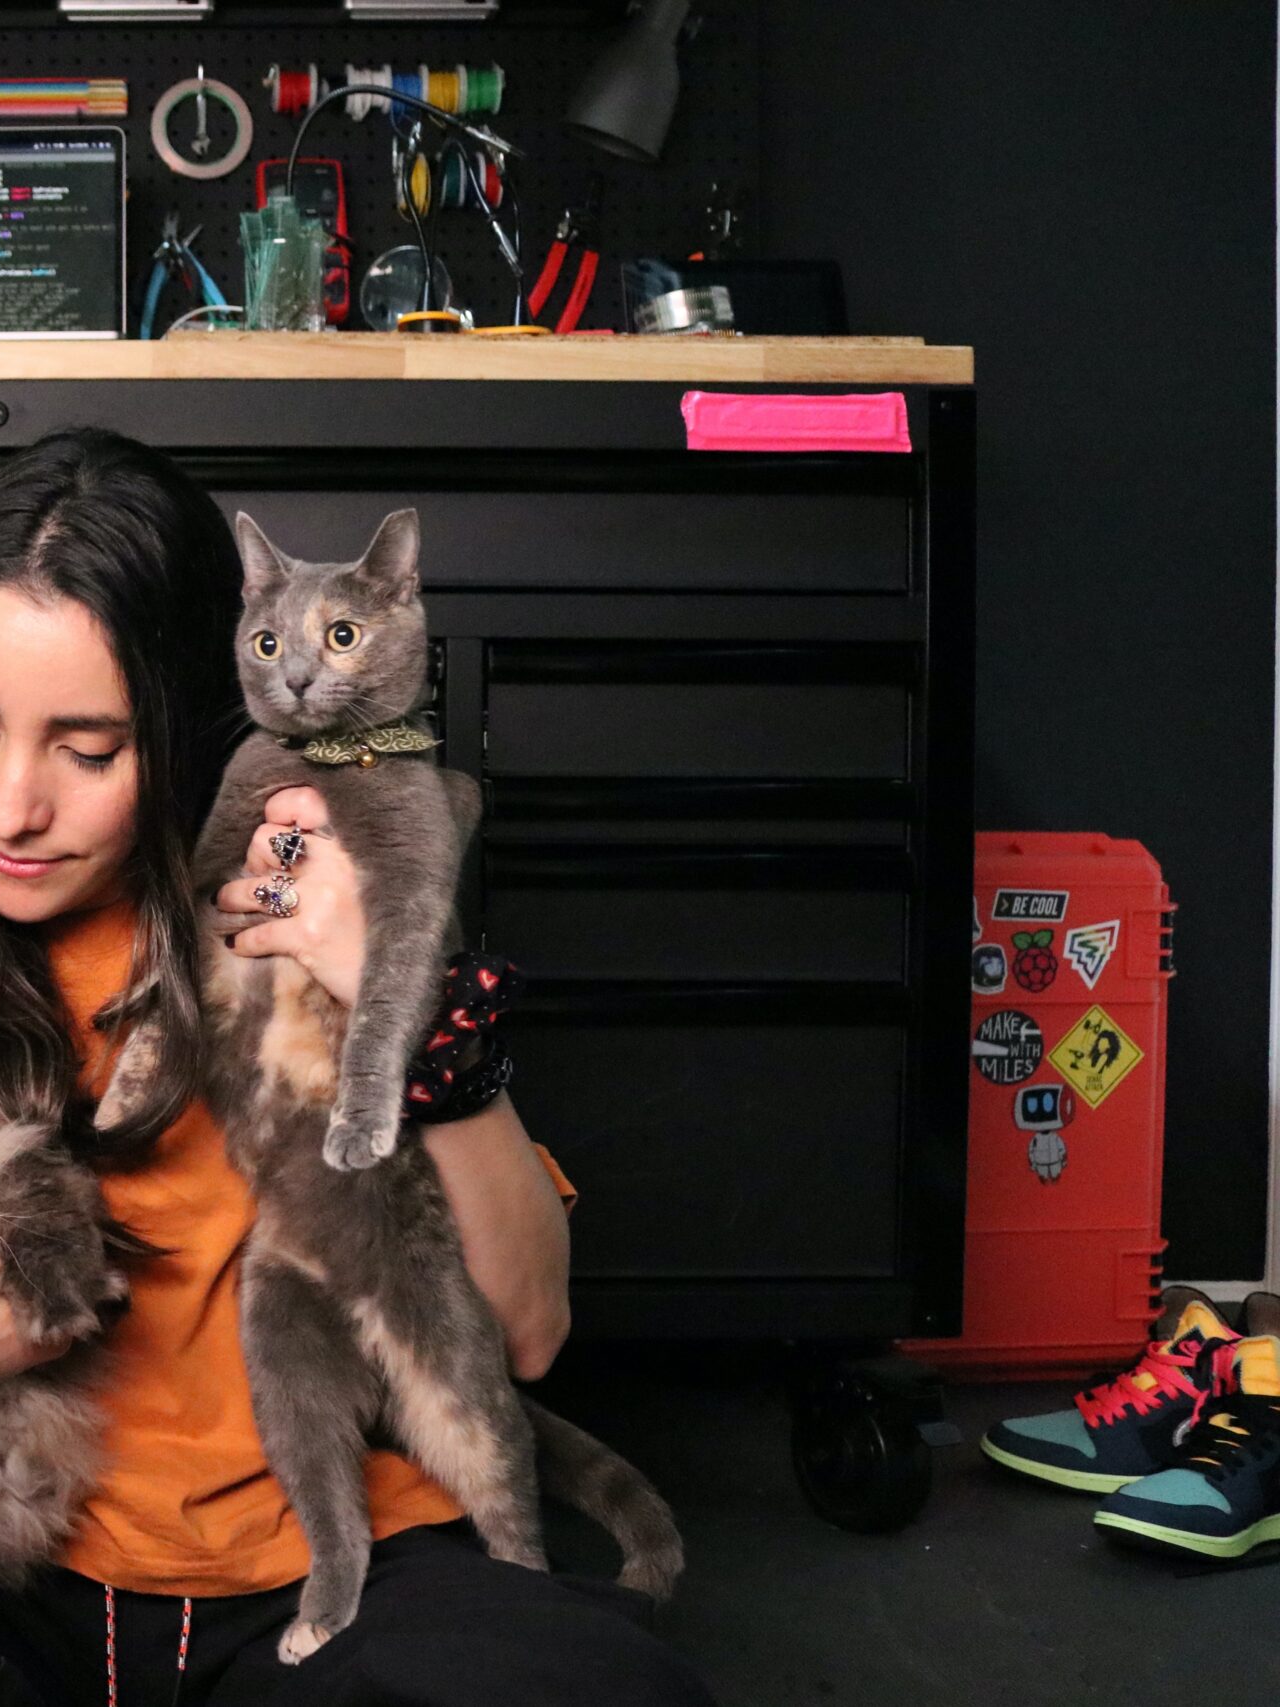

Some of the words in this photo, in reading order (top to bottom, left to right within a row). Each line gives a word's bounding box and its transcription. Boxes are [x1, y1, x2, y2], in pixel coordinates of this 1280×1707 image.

[1013, 895, 1028, 915] BE
[1030, 896, 1059, 916] COOL
[980, 1011, 1022, 1040] MAKE
[1009, 1042, 1041, 1058] WITH
[981, 1058, 1035, 1082] MILES
